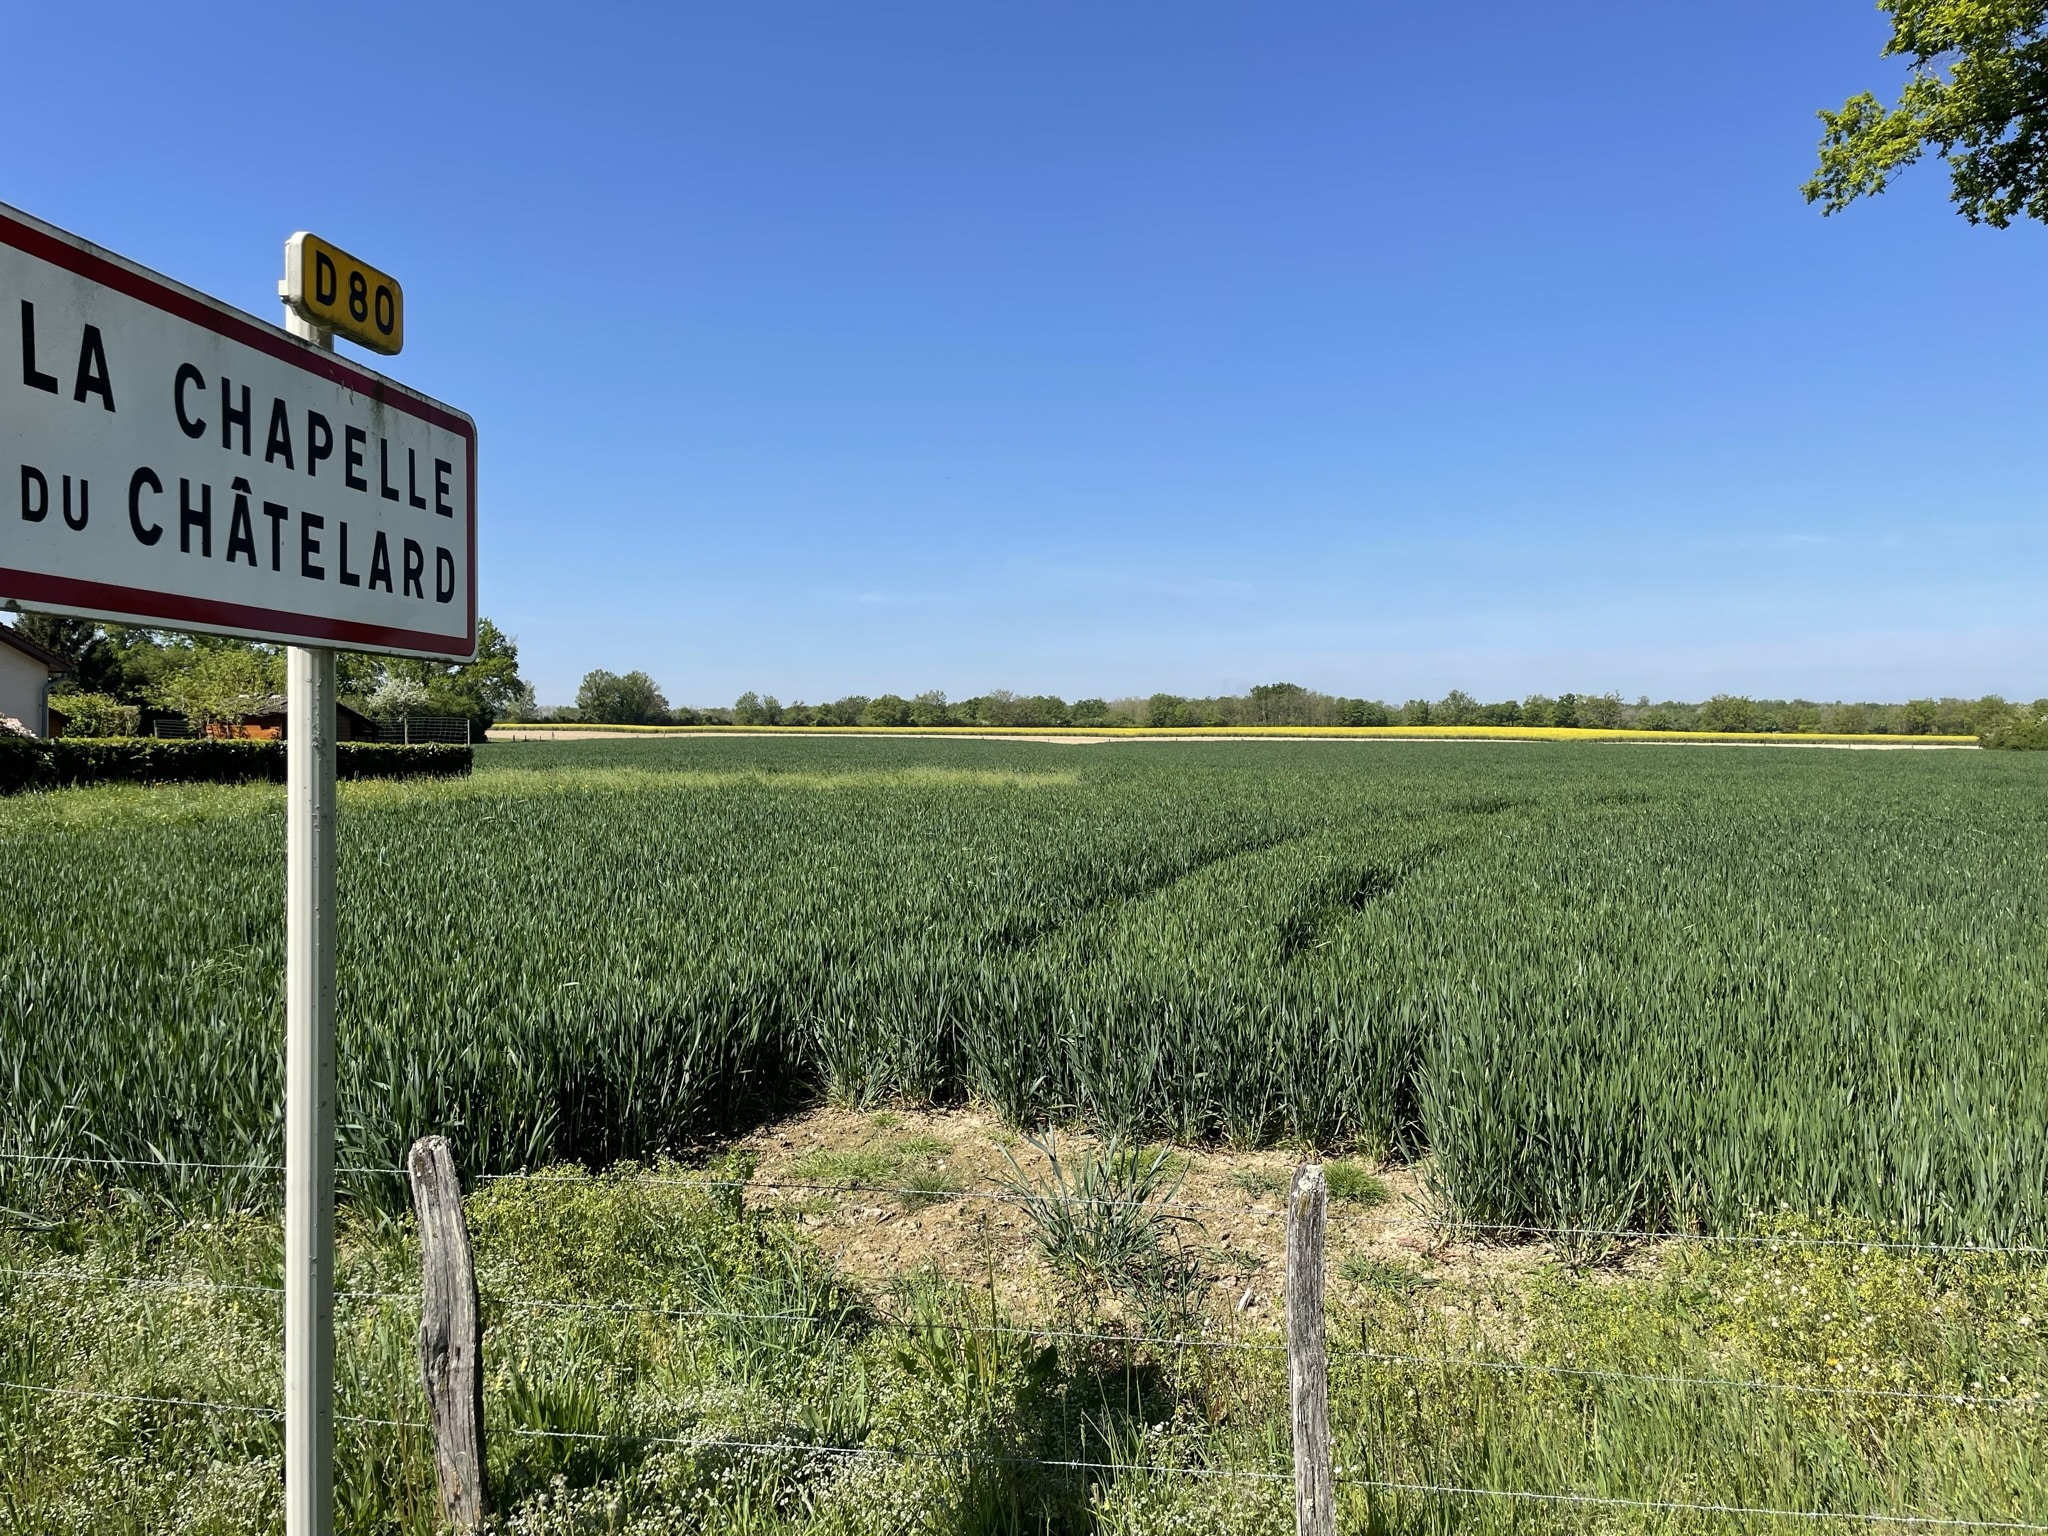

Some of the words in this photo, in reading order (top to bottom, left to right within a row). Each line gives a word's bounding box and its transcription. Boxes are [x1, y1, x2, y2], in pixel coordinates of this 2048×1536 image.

[315, 251, 337, 306] D
[348, 271, 395, 335] 80
[20, 299, 117, 414] LA
[173, 362, 454, 519] CHAPELLE
[20, 464, 89, 532] DU
[128, 466, 456, 604] CHÂTELARD
